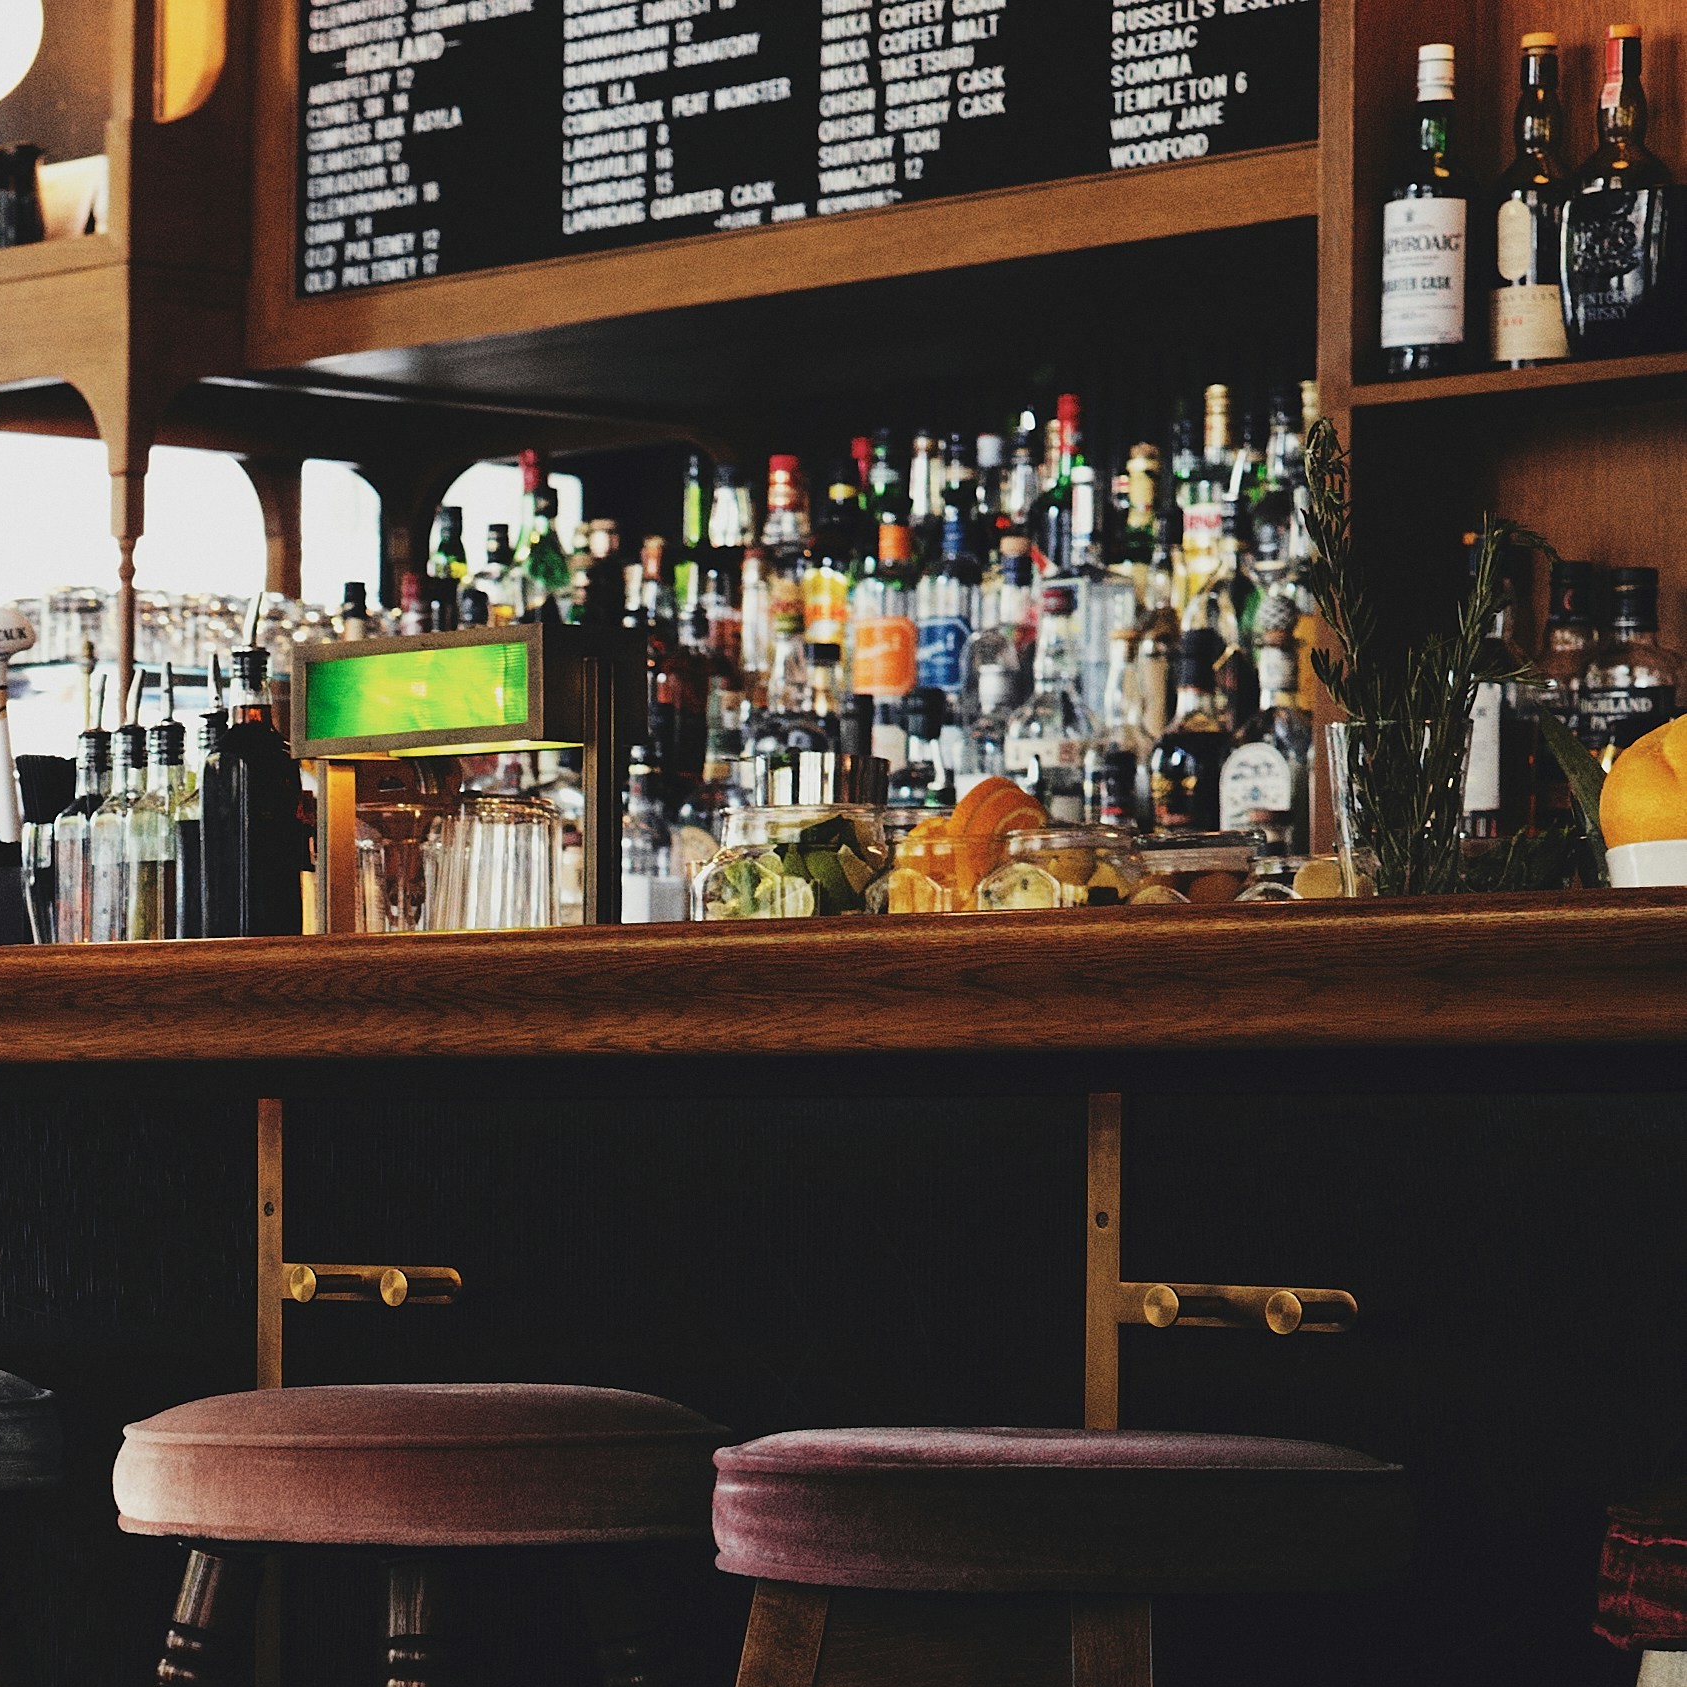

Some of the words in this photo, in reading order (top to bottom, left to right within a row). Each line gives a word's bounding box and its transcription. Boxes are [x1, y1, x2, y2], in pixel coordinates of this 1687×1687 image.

[821, 11, 872, 41] NIKKA
[879, 0, 946, 31] COFFEY
[1111, 0, 1217, 35] RUSSELL'S
[346, 31, 445, 76] HIGHLAND
[820, 38, 871, 68] NIKKA
[878, 24, 945, 57] COFFEY
[951, 13, 1000, 44] MALT
[1110, 25, 1199, 61] SAZERAC
[820, 63, 869, 93] NIKKA
[956, 65, 1006, 94] CASK
[1110, 53, 1193, 88] SONOMA
[957, 91, 1006, 119] CASK
[1112, 73, 1228, 115] TEMPLETON
[1234, 71, 1248, 94] 6
[1110, 110, 1173, 141] WIDOW
[1176, 101, 1226, 131] JANE
[818, 135, 896, 169] SUNTORY
[1109, 133, 1210, 170] WOODFORD
[730, 180, 775, 208] CASK
[304, 244, 338, 270] OLD
[304, 269, 337, 294] OLD
